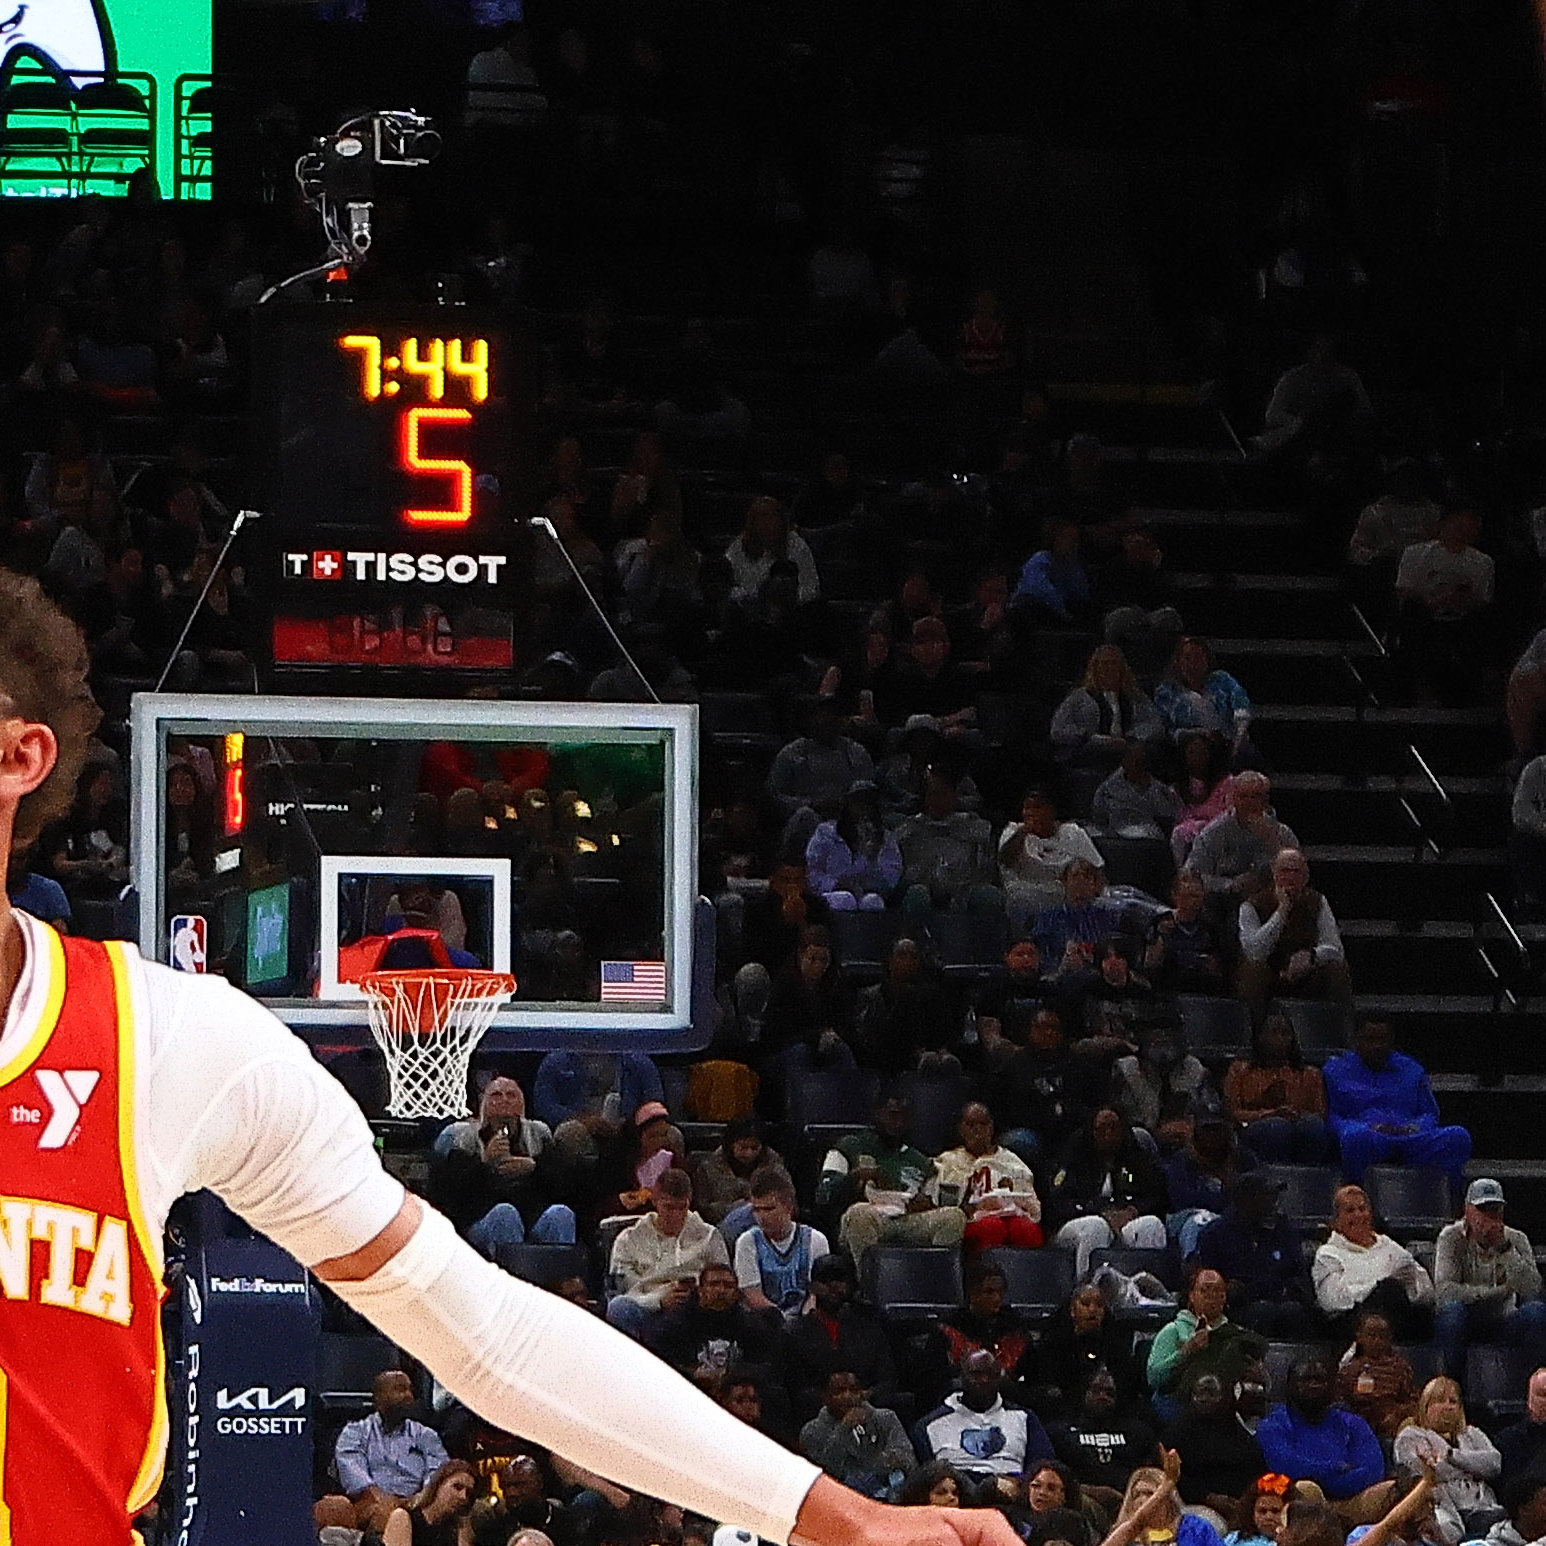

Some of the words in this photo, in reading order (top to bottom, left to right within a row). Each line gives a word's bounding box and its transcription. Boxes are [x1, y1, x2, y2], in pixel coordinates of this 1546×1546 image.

[340, 335, 490, 400] 7:44
[403, 406, 473, 524] 5
[347, 552, 507, 584] TISSOT
[11, 1104, 41, 1124] the
[34, 1069, 101, 1149] Y
[217, 1387, 306, 1410] KIA
[217, 1417, 306, 1434] GOSSETT
